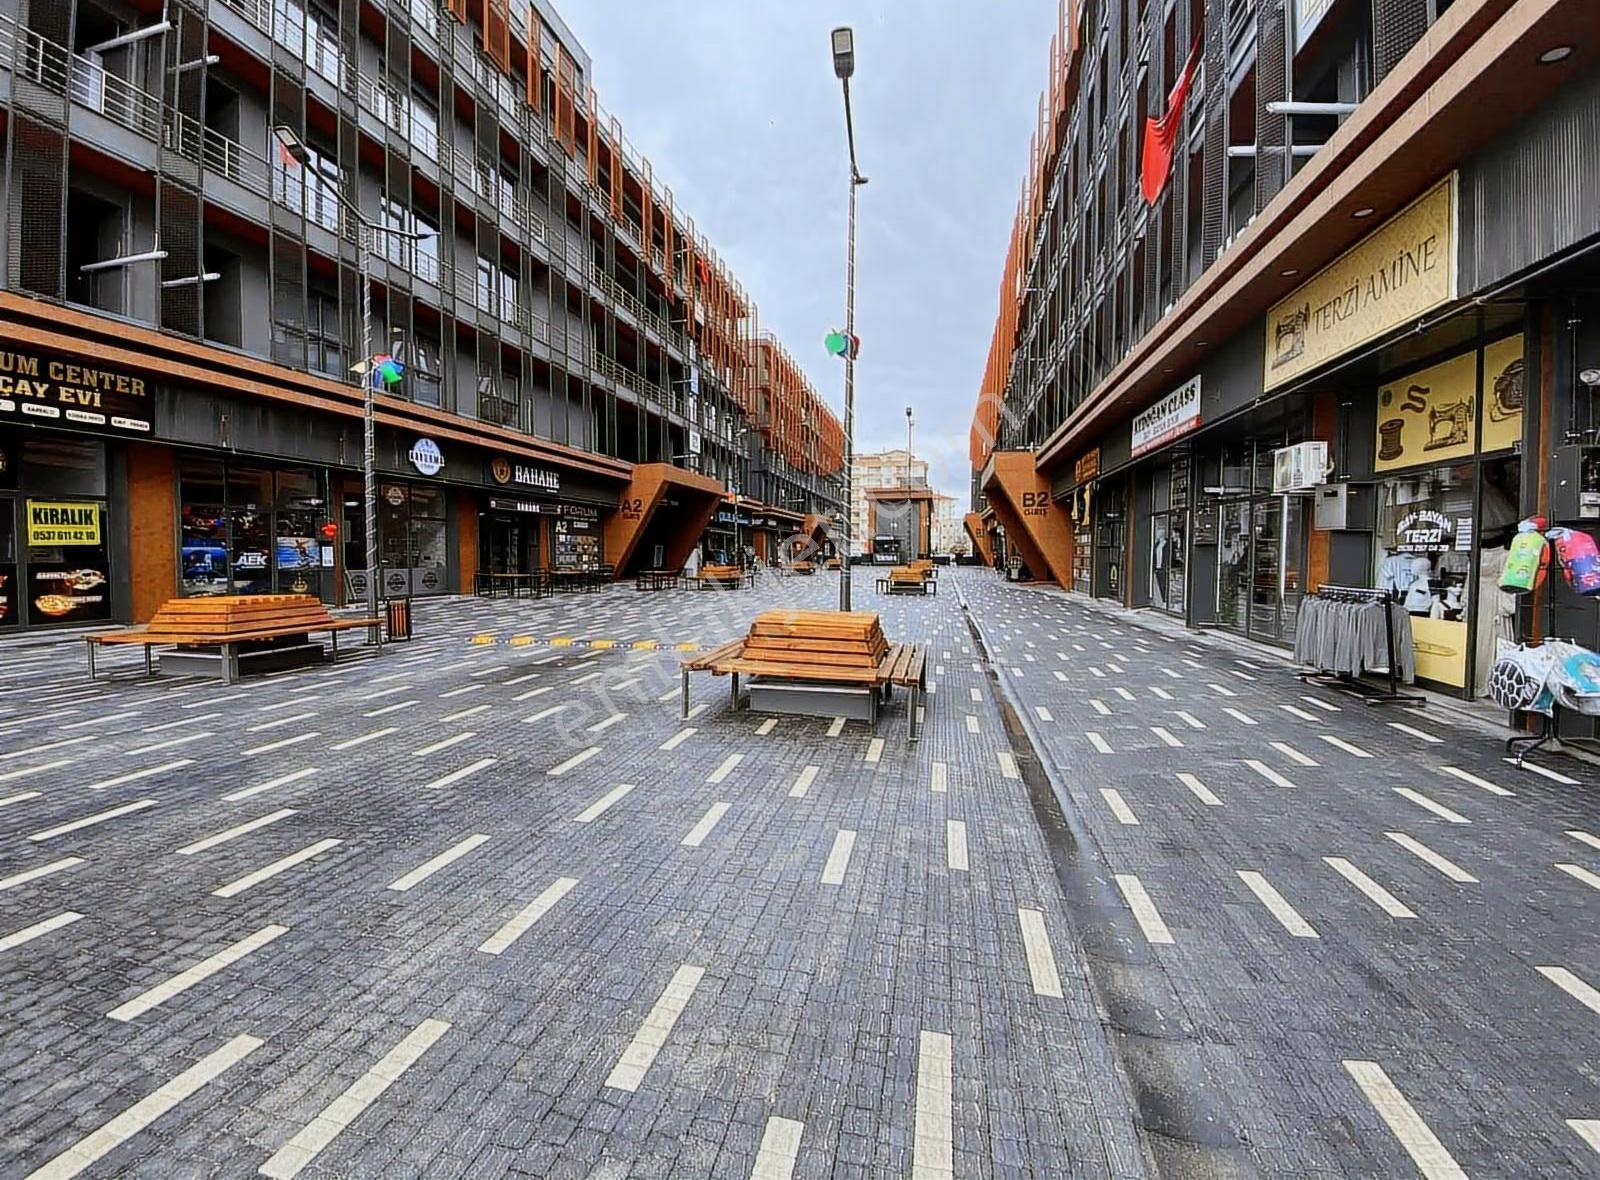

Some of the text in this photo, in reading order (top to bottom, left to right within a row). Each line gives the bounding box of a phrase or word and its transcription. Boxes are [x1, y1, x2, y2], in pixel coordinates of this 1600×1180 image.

[1313, 235, 1436, 335] TERZİ AMİNE
[49, 362, 146, 396] CENTER
[59, 387, 102, 407] EVİ
[621, 499, 642, 513] A2
[1022, 492, 1049, 508] B2
[555, 520, 568, 533] A2
